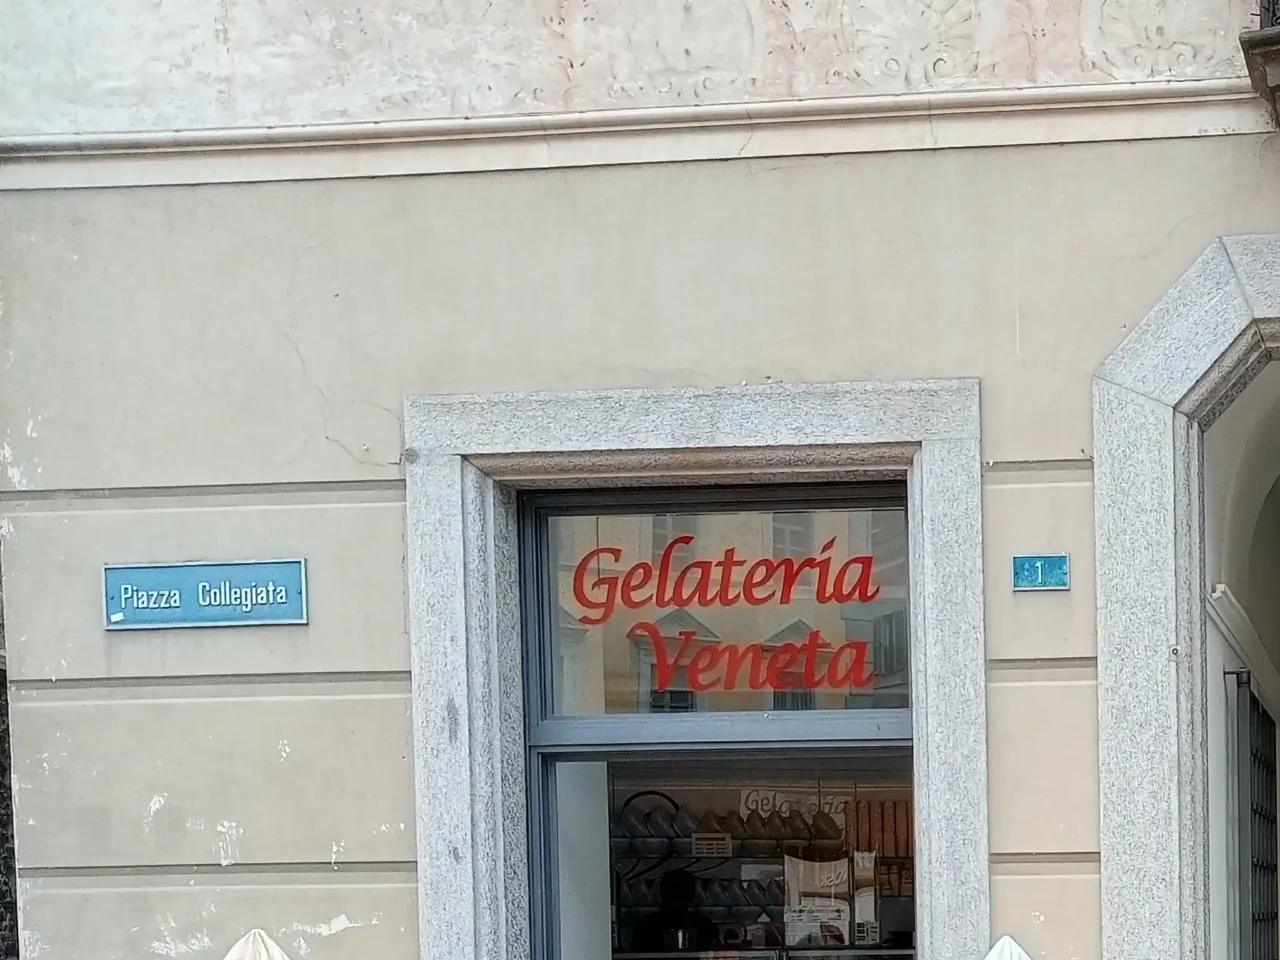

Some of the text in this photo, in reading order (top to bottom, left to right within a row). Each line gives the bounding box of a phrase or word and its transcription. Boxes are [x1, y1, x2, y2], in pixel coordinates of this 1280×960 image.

[1034, 561, 1043, 585] 1
[120, 580, 288, 613] Piazza Collegiata
[626, 621, 876, 693] Veneta
